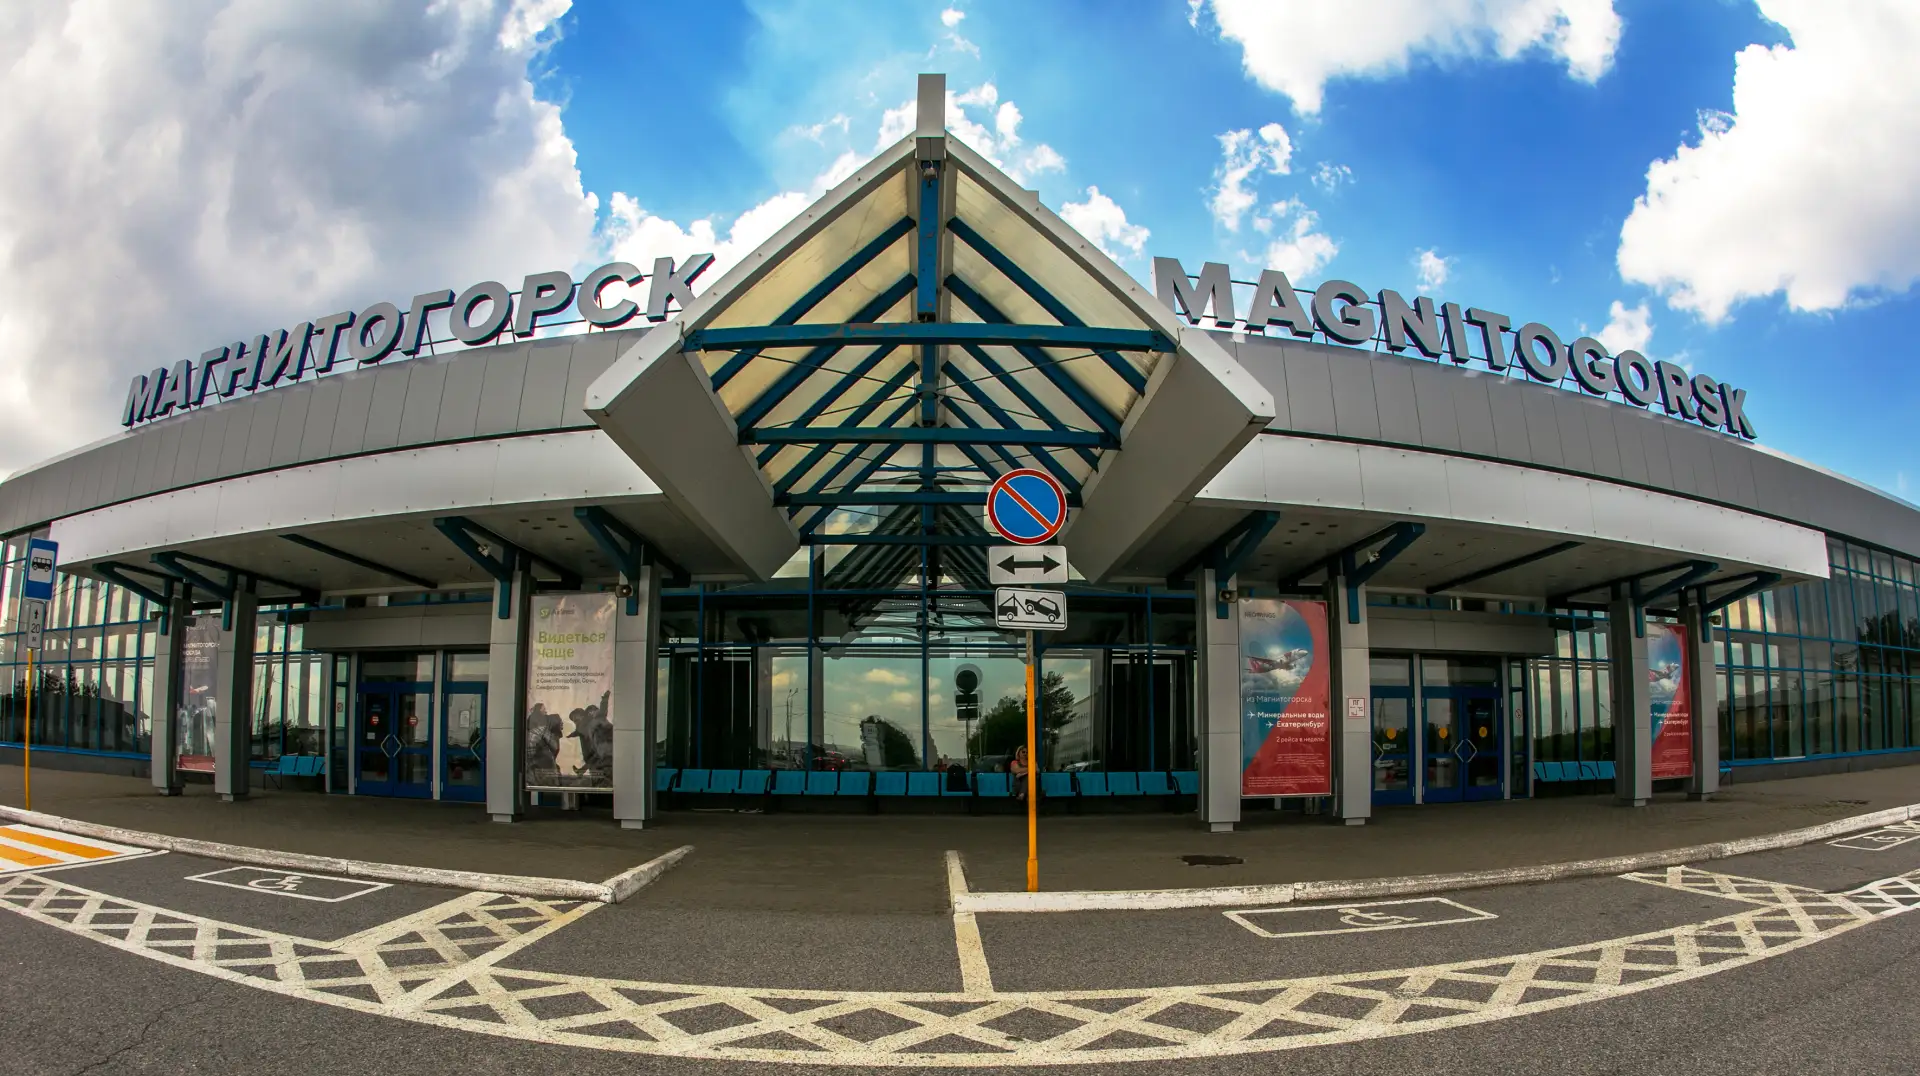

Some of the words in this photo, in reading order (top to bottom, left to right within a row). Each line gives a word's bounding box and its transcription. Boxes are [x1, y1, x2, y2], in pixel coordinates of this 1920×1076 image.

[122, 253, 715, 426] МАГНИТОГОРСК
[1151, 256, 1757, 439] MAGNITOGORSK
[31, 623, 40, 633] 20
[539, 631, 605, 644] Видеться
[538, 648, 574, 660] чаще
[1257, 695, 1311, 704] Магнитогорска
[1258, 711, 1306, 719] Минеральные
[1277, 720, 1324, 728] Екатеринбург
